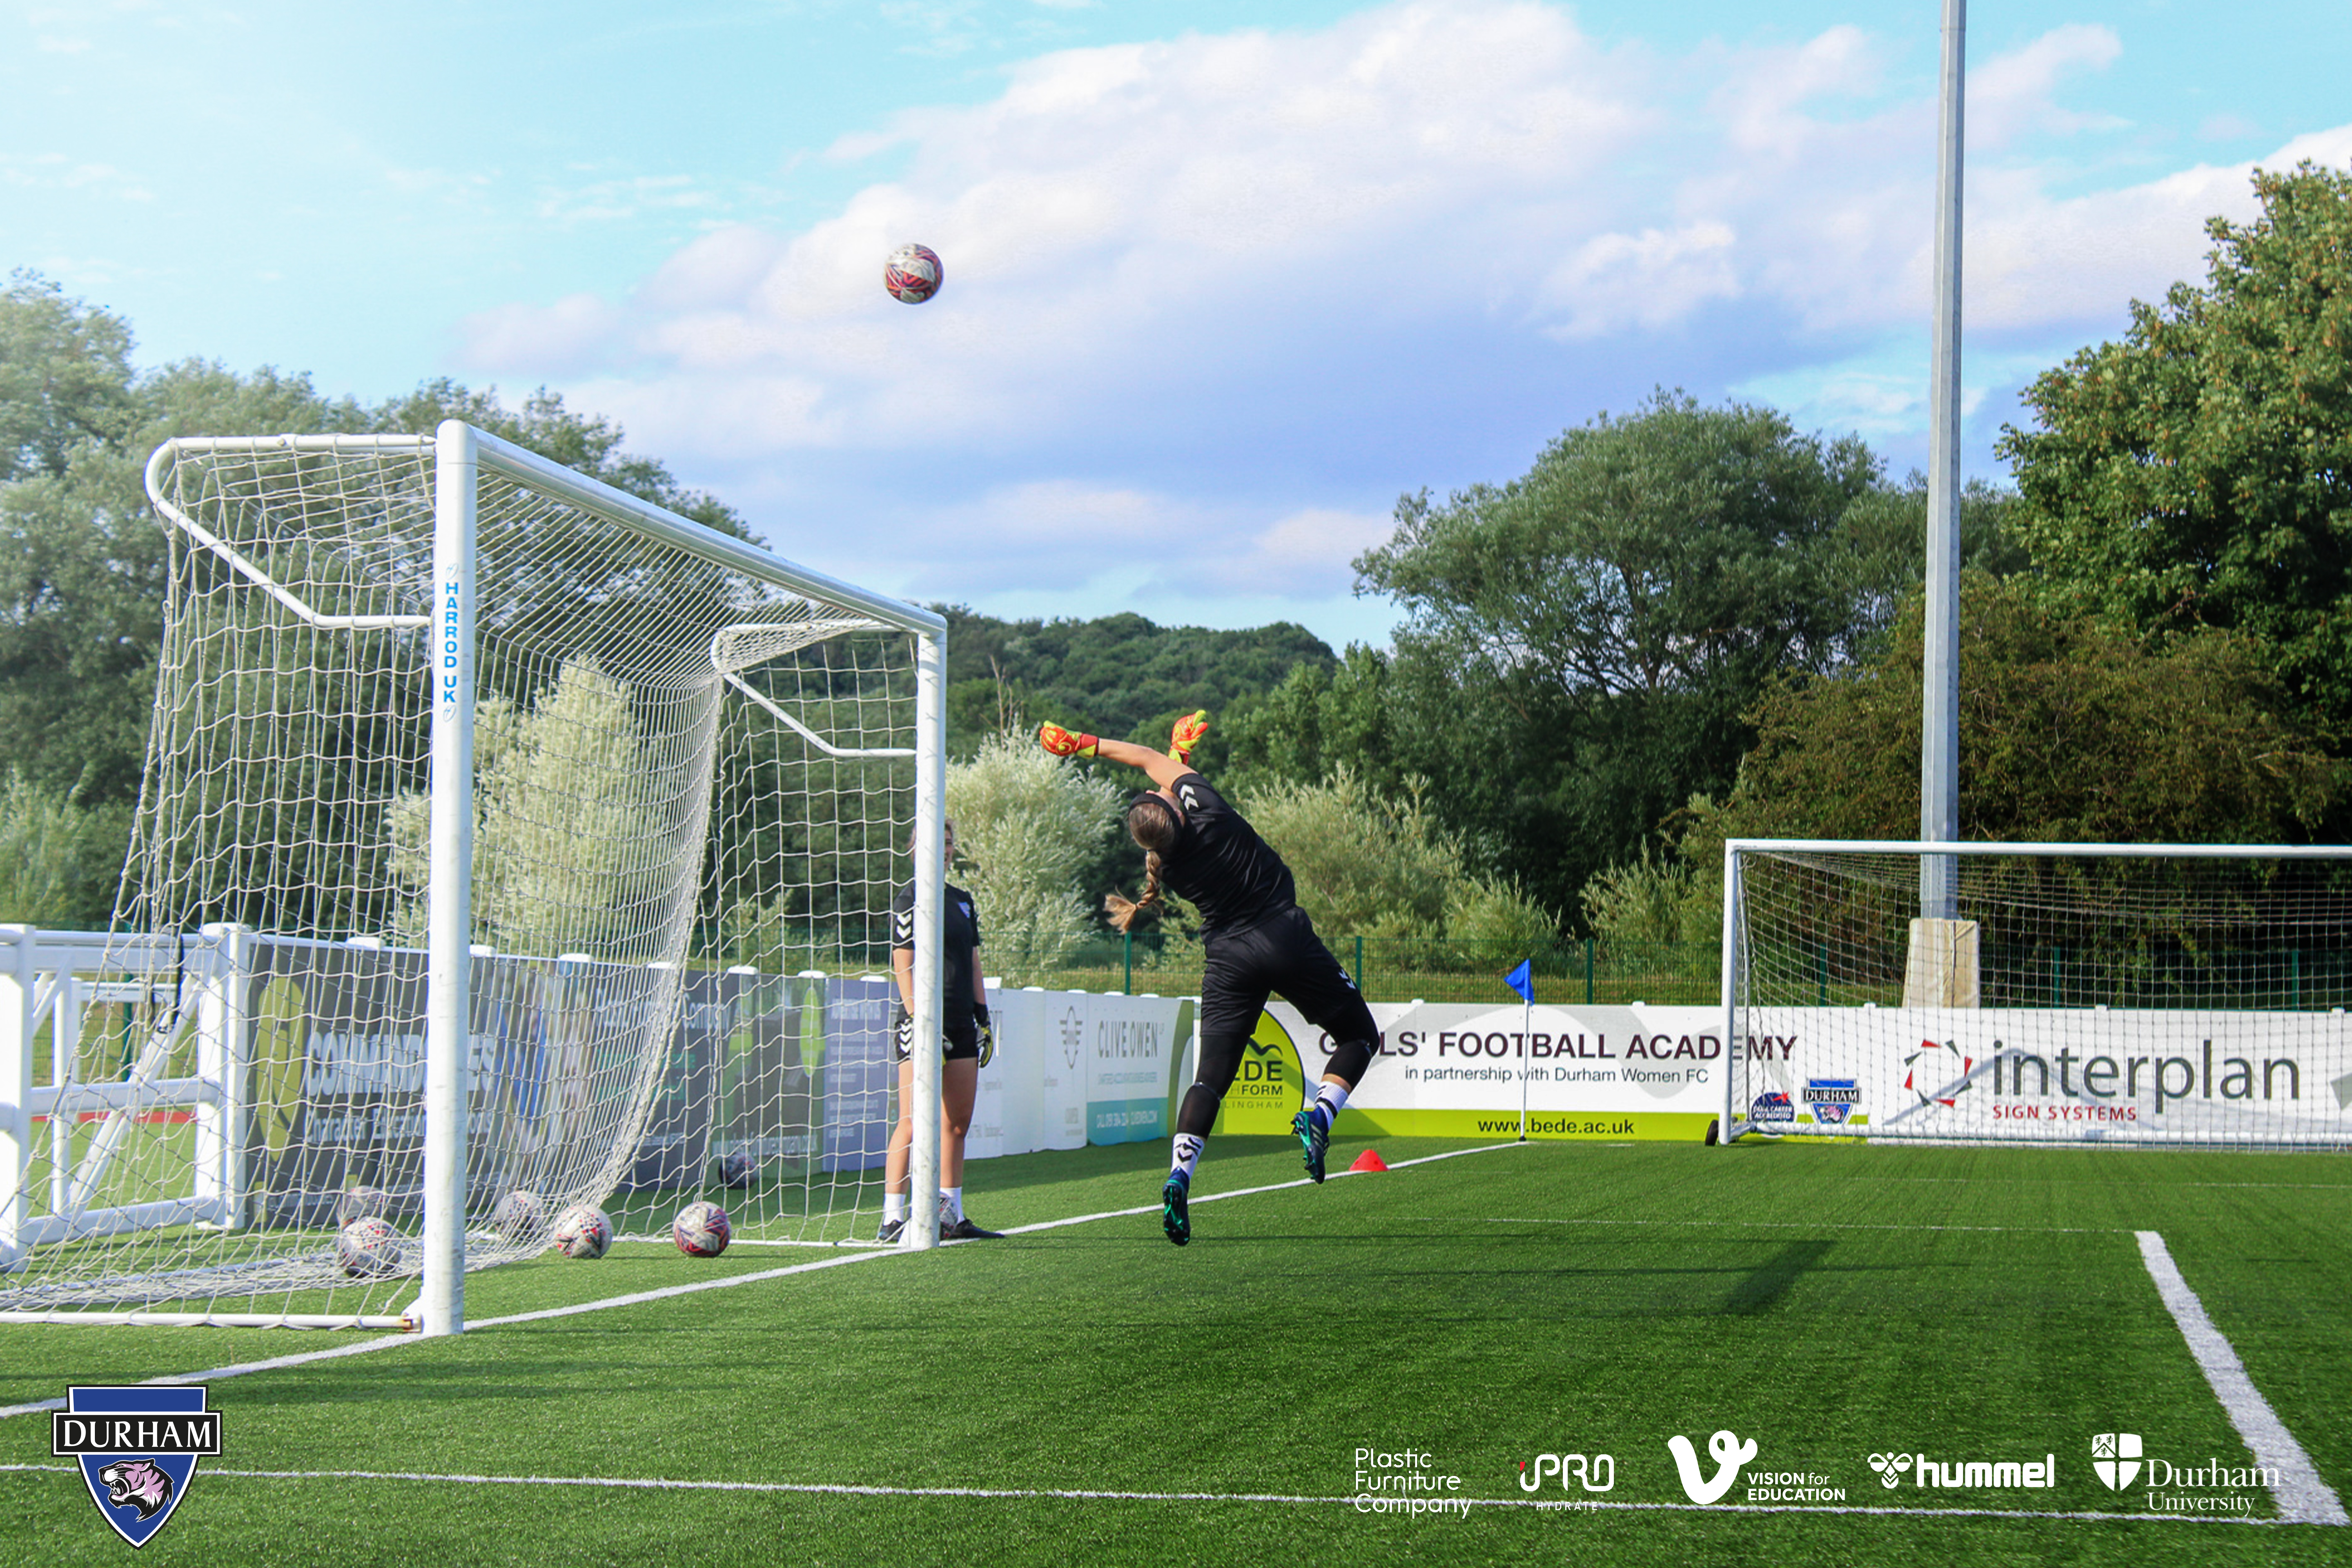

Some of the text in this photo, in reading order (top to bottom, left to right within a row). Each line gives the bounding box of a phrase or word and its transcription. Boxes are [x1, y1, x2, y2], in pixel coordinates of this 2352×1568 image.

[443, 583, 458, 703] HARROD UK
[1098, 1020, 1127, 1058] CLIVE
[1130, 1021, 1158, 1058] OWEN
[1319, 1031, 1798, 1060] GLS' FOOTBALL ACADEMY
[305, 1032, 428, 1096] COMMAND
[1235, 1060, 1283, 1081] DE
[1405, 1066, 1709, 1083] in partnership with Durham Women FC
[1993, 1040, 2299, 1114] interplan
[1231, 1085, 1283, 1096] HFORM
[1806, 1090, 1858, 1102] DURHAM
[1225, 1101, 1283, 1109] LINGHAM
[1993, 1105, 2137, 1121] SIGN SYSTEMS
[1477, 1118, 1635, 1134] www.bede.ac.uk
